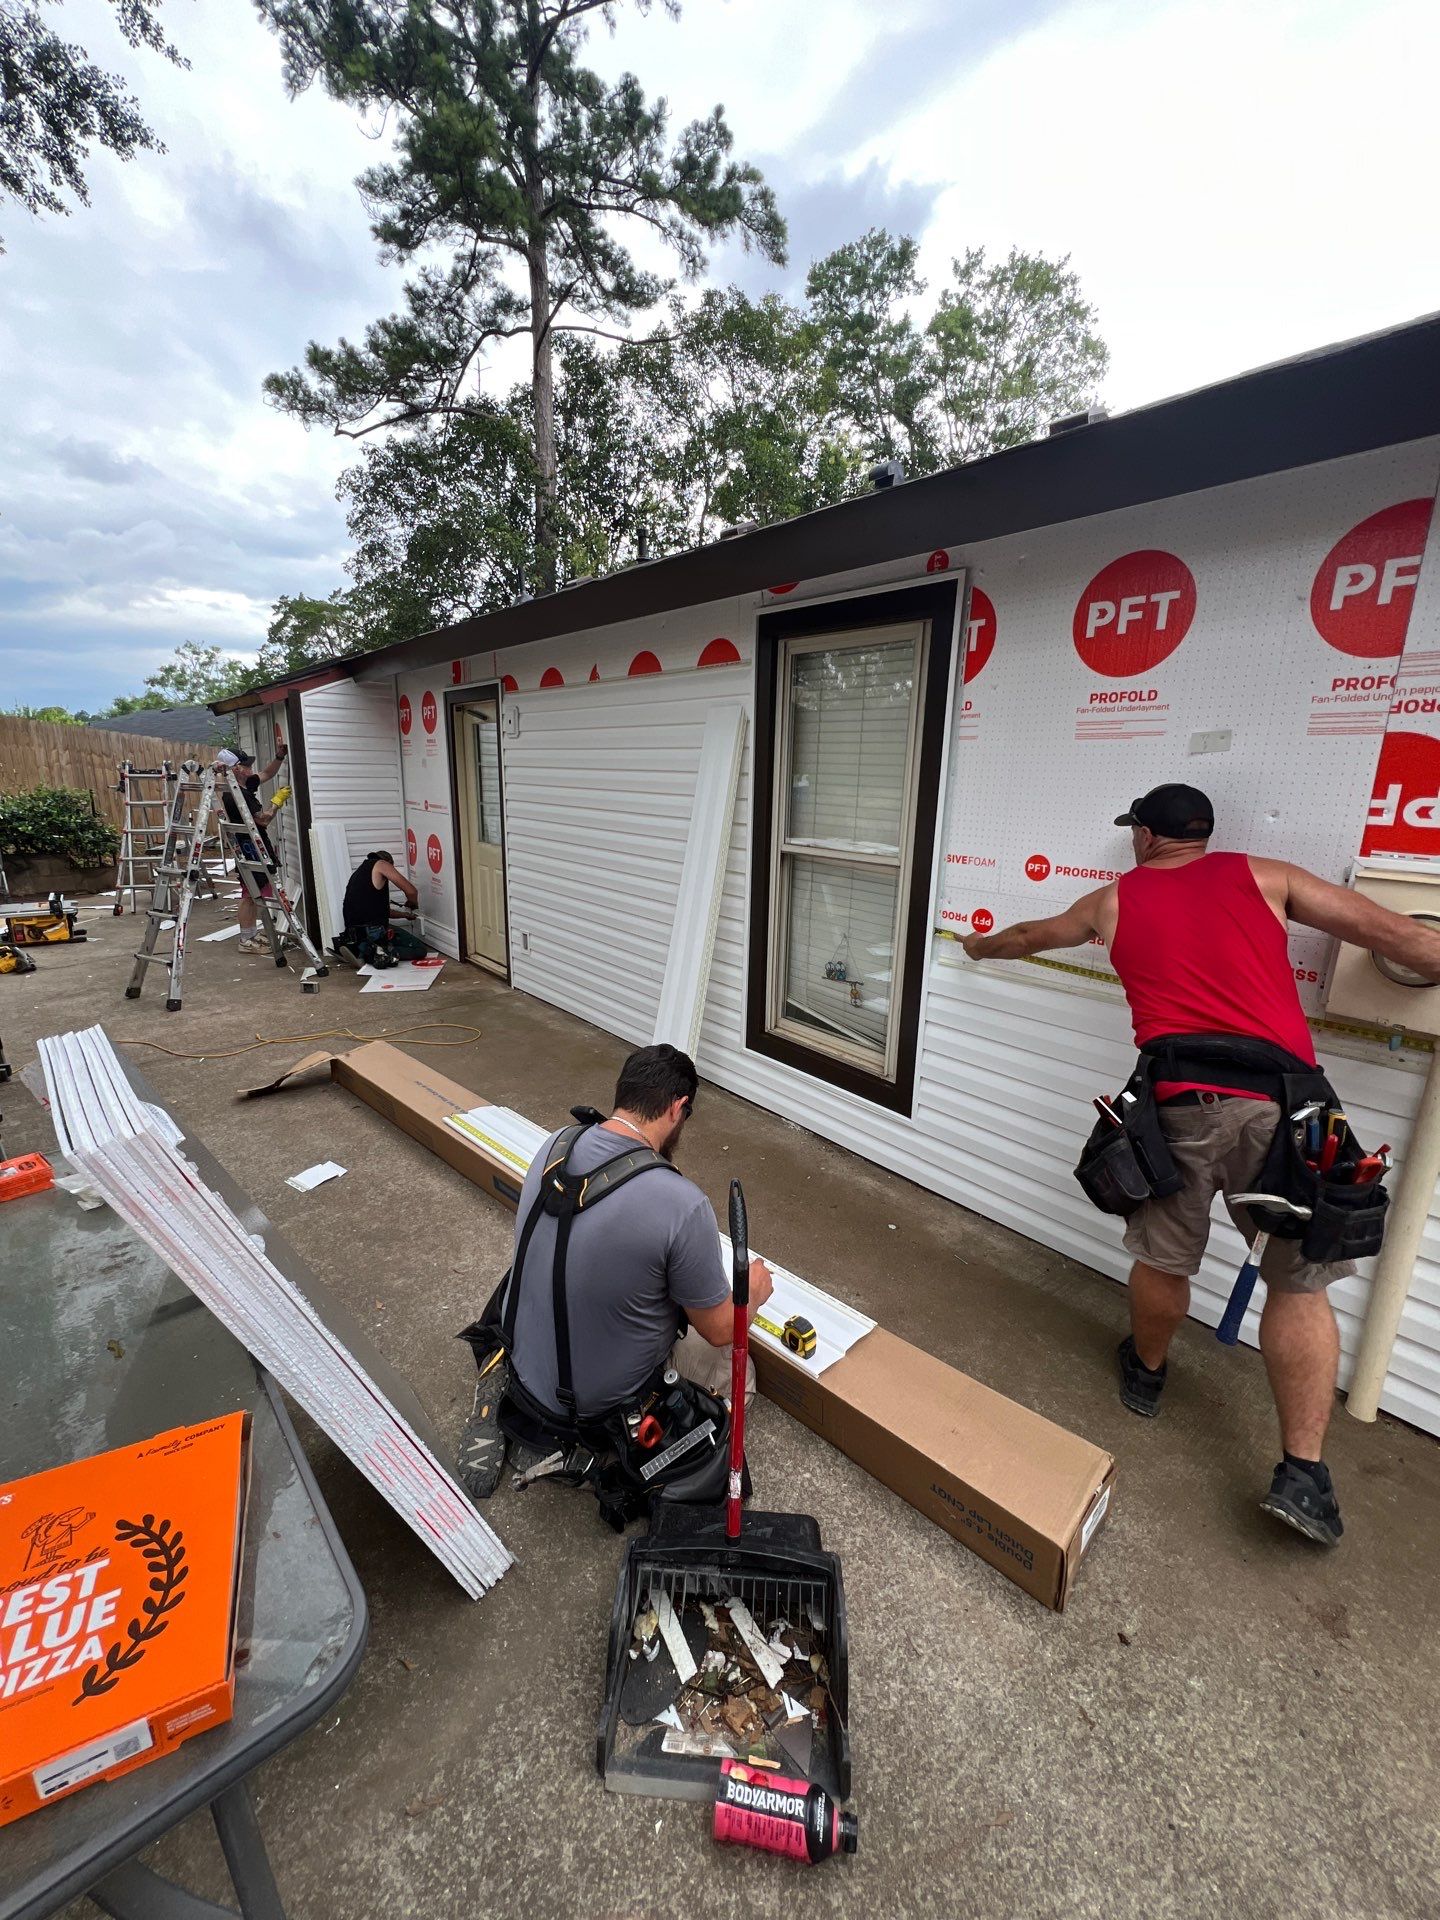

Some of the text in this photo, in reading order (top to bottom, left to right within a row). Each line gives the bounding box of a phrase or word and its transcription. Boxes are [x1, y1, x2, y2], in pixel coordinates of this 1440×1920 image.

[1329, 554, 1422, 611] PF
[1085, 590, 1181, 639] PFT
[1089, 689, 1159, 705] PROFOLD
[1311, 694, 1370, 704] Fan-Folded
[423, 705, 436, 720] PFT
[1076, 703, 1170, 714] Fan-Folded Underlayment
[428, 846, 441, 861] PFT
[944, 854, 996, 868] SIVEFOAM
[1027, 864, 1048, 873] PFT
[940, 910, 992, 927] PFT PROG
[185, 1423, 225, 1441] COMPANY
[57, 1558, 81, 1574] to
[84, 1546, 109, 1564] be
[987, 1532, 1034, 1571] Double
[0, 1558, 110, 1629] EST
[0, 1587, 122, 1668] LUE
[727, 1780, 805, 1818] BODYARMOR
